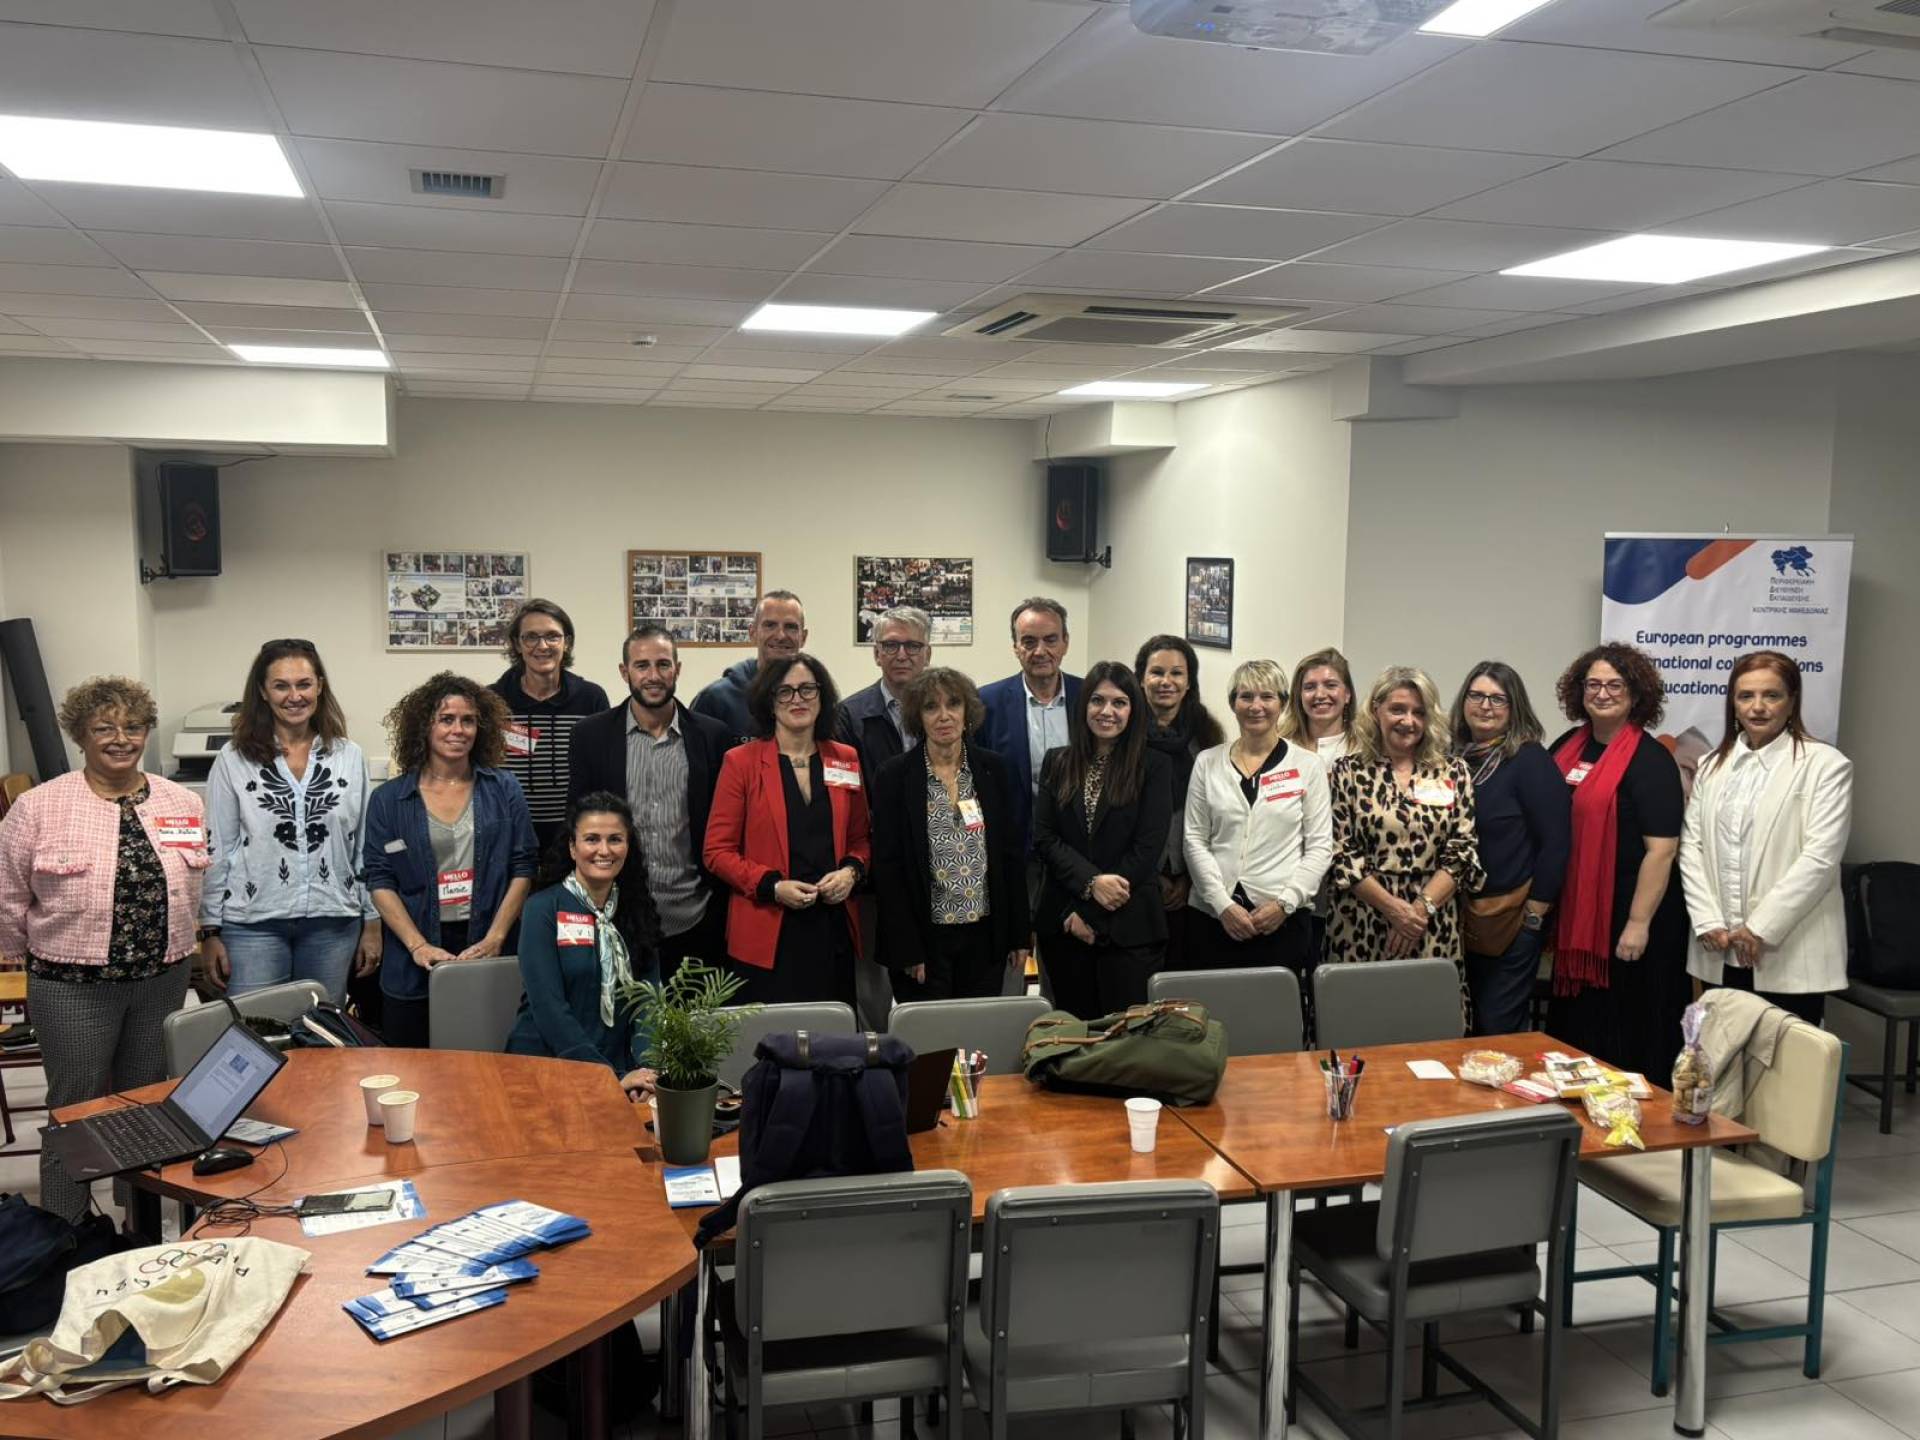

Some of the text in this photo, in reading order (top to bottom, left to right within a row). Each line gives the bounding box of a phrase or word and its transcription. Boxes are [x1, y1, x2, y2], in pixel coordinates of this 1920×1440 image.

[1636, 630, 1808, 648] European programmes
[1653, 655, 1712, 670] national
[1664, 680, 1728, 695] ucationa
